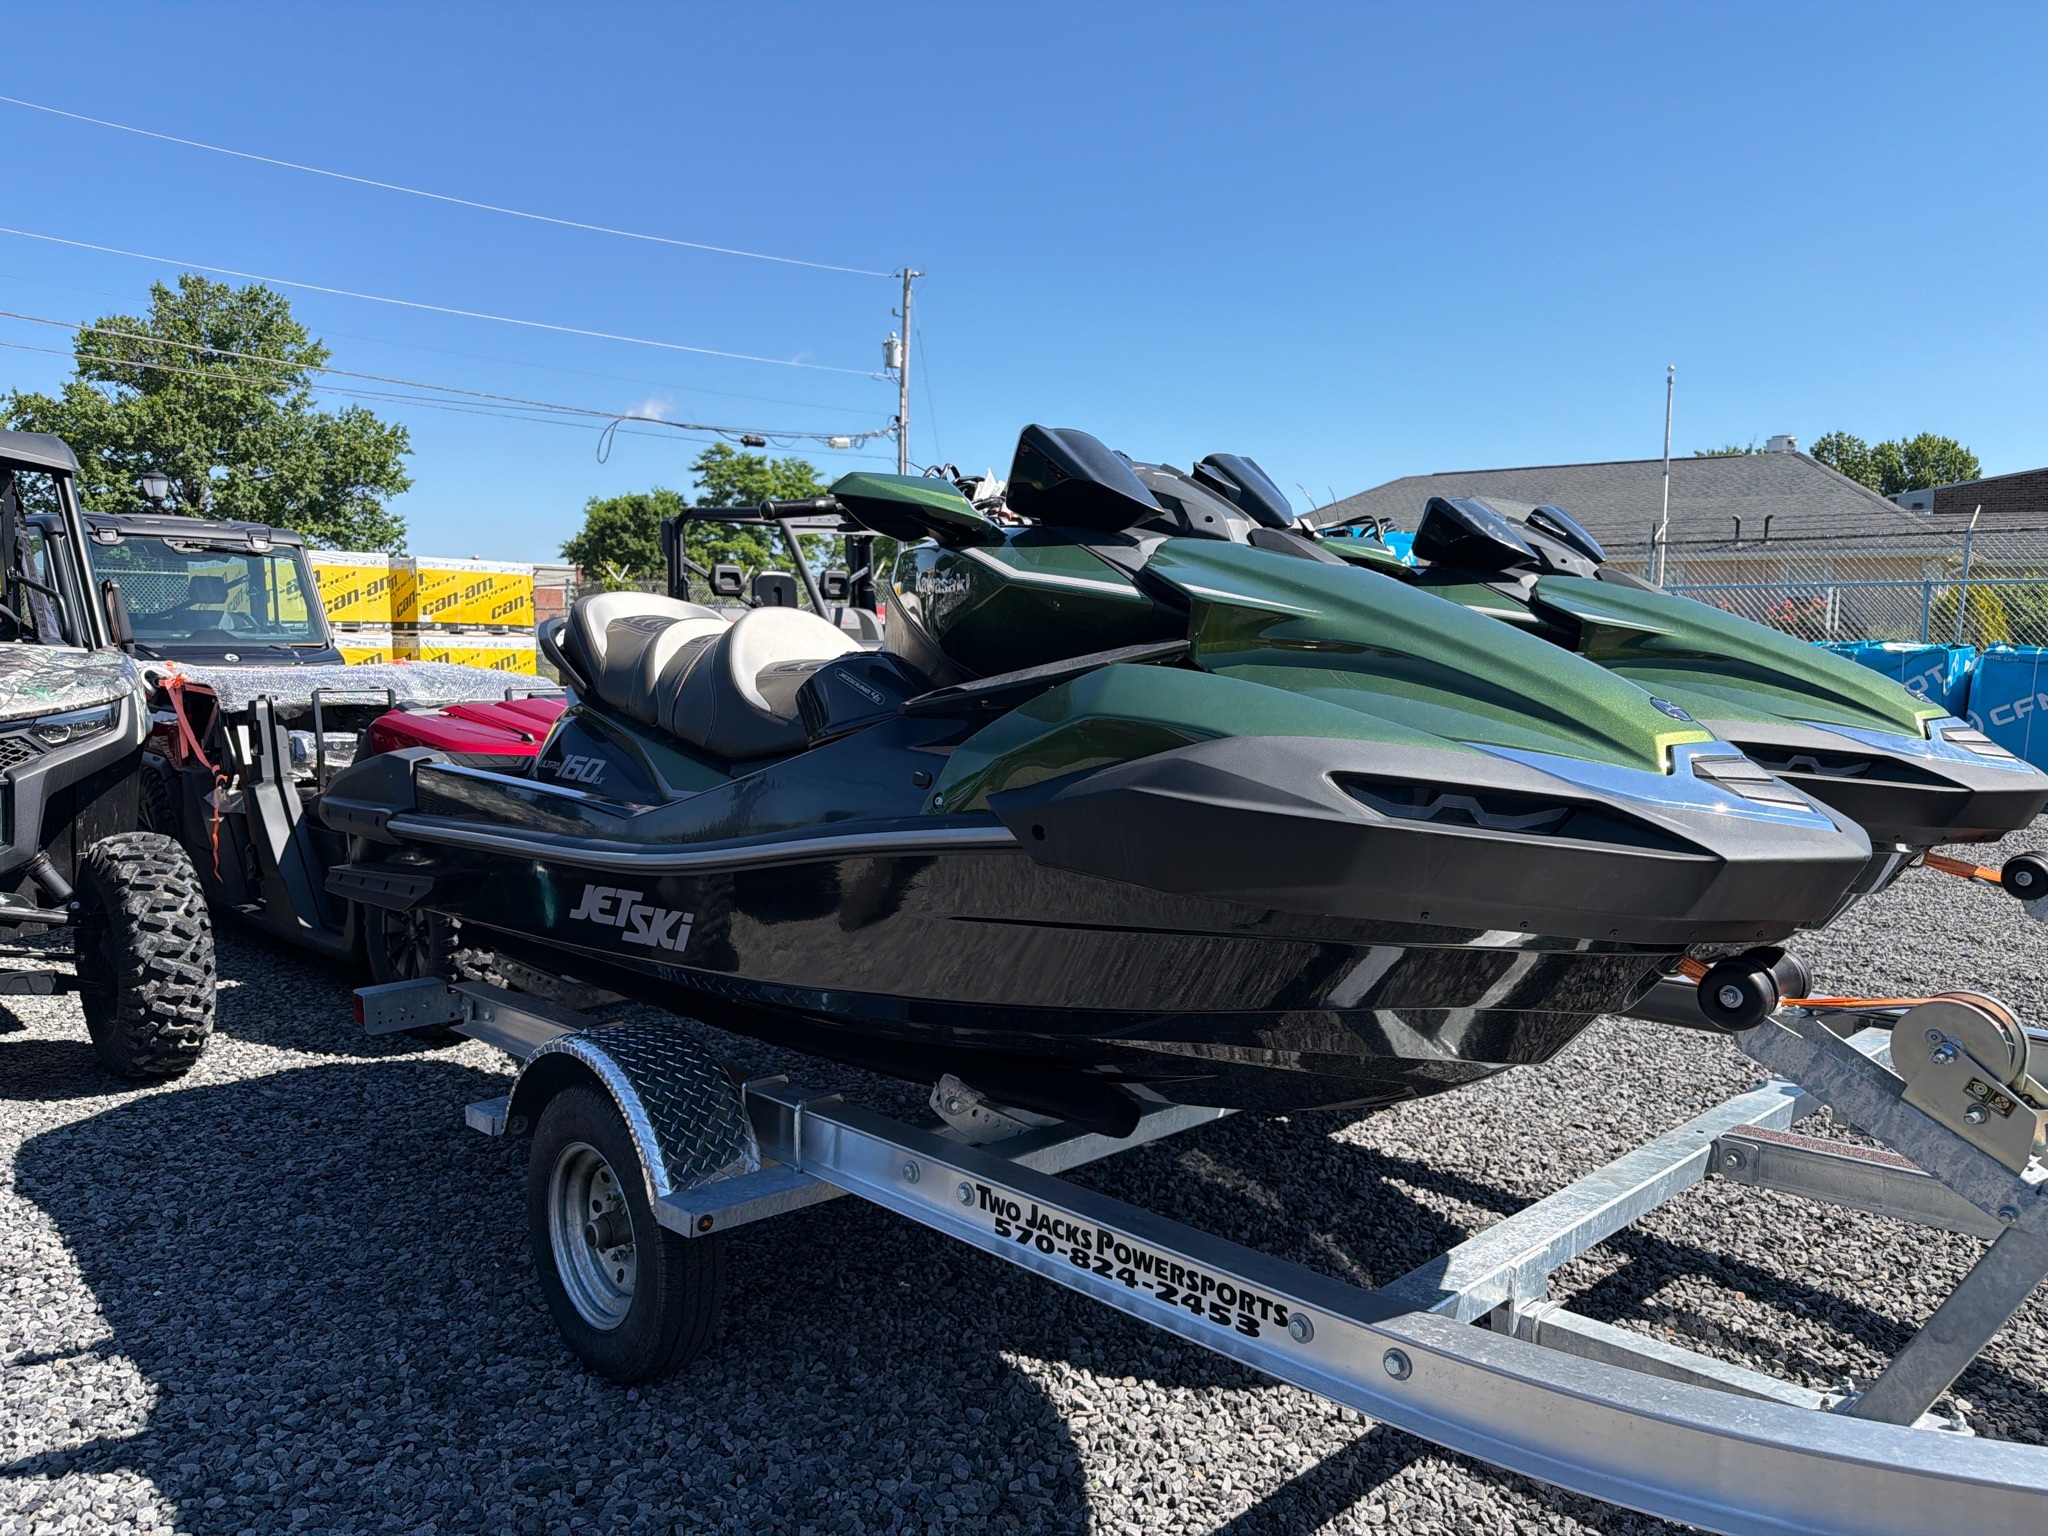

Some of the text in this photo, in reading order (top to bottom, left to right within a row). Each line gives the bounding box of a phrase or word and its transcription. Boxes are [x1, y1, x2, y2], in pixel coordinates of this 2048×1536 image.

[422, 577, 493, 616] can-am
[916, 571, 971, 595] Kawasaki
[491, 595, 534, 621] can-
[555, 754, 606, 784] 160
[593, 776, 605, 785] LX
[569, 883, 644, 928] JET
[994, 1217, 1260, 1338] 570-824-2453
